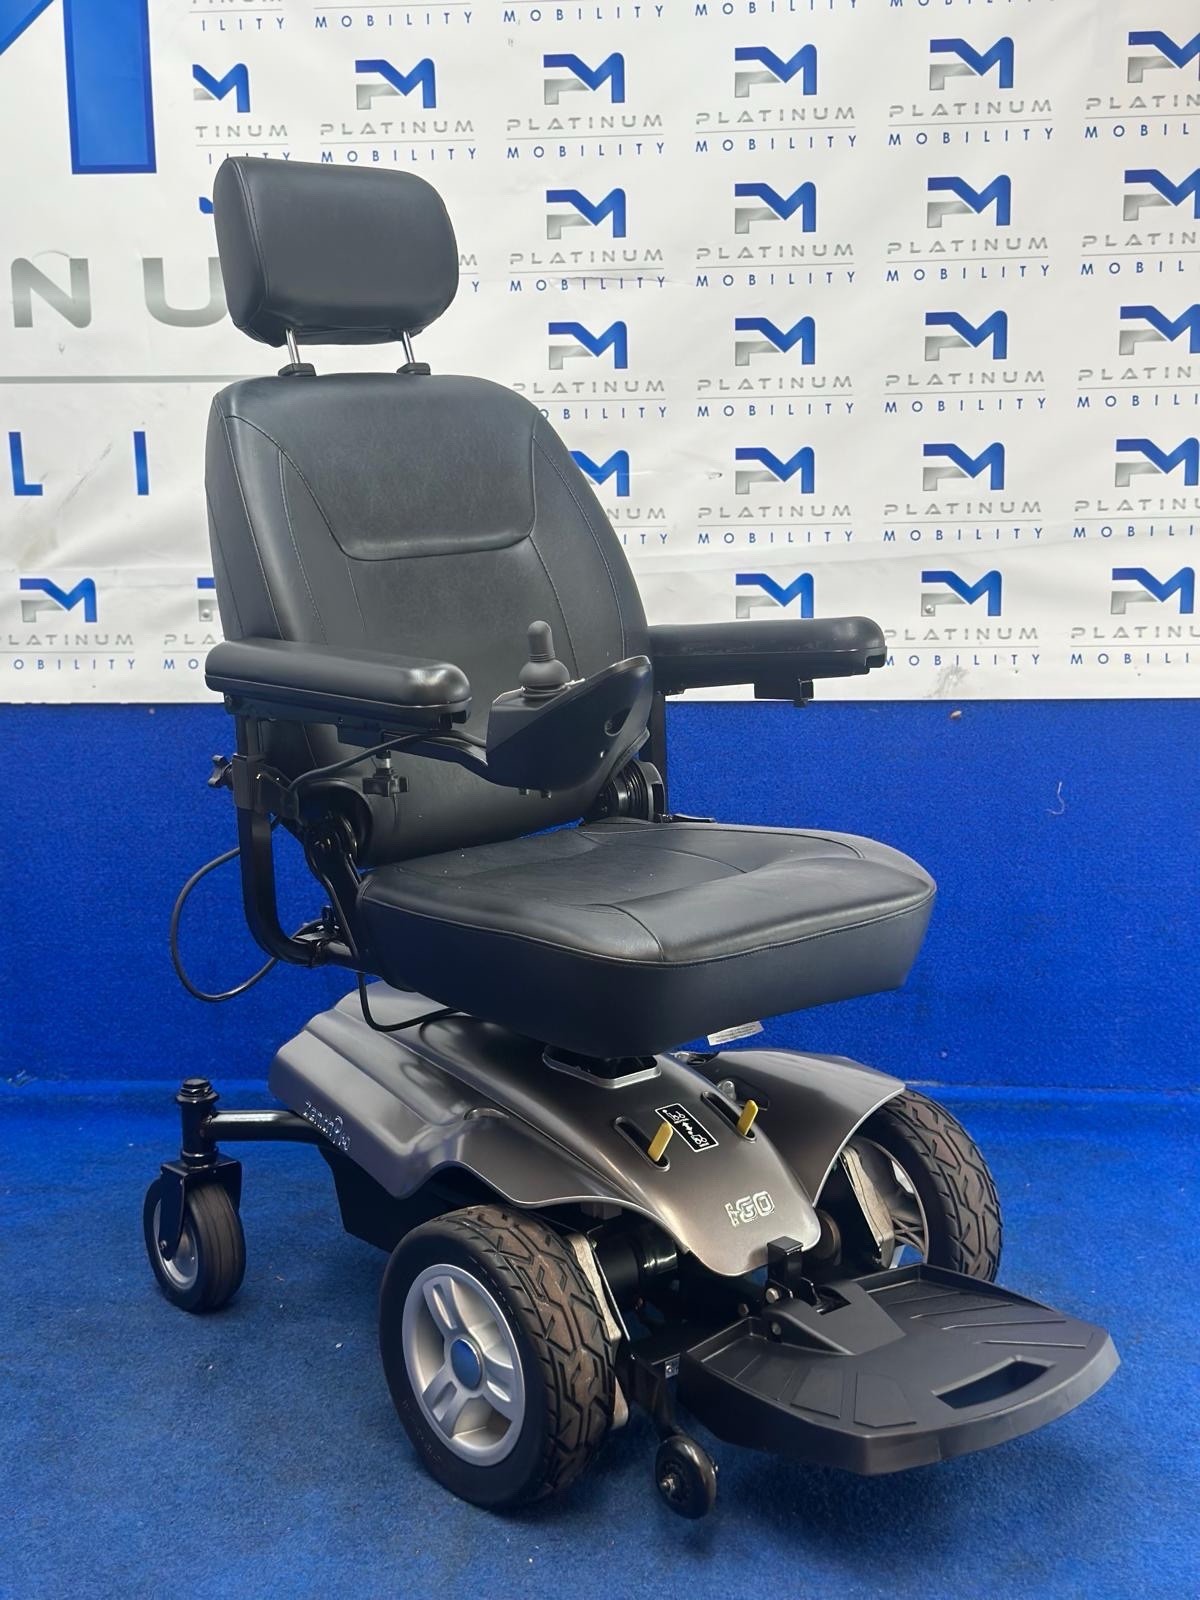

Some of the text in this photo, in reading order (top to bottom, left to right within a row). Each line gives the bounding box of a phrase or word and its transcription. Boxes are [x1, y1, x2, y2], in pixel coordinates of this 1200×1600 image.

[315, 12, 472, 28] MOBILITY
[504, 5, 663, 22] MOBILITY
[696, 107, 855, 125] PLATINUM
[890, 100, 1051, 117] PLATINUM
[321, 120, 474, 135] PLATINUM
[507, 115, 662, 131] PLATINUM
[696, 135, 856, 152] MOBILITY
[889, 128, 1053, 145] MOBILITY
[321, 148, 476, 162] MOBILITY
[507, 142, 664, 159] MOBILITY
[697, 244, 853, 260] PLATINUM
[888, 237, 1048, 254] PLATINUM
[510, 249, 663, 264] PLATINUM
[696, 272, 855, 287] MOBILITY
[886, 265, 1049, 282] MOBILITY
[510, 276, 665, 291] MOBILITY
[698, 376, 852, 391] PLATINUM
[886, 371, 1044, 386] PLATINUM
[697, 403, 854, 417] MOBILITY
[885, 398, 1046, 413] MOBILITY
[698, 505, 851, 518] PLATINUM
[884, 502, 1041, 515] PLATINUM
[698, 531, 852, 544] MOBILITY
[884, 528, 1042, 541] MOBILITY
